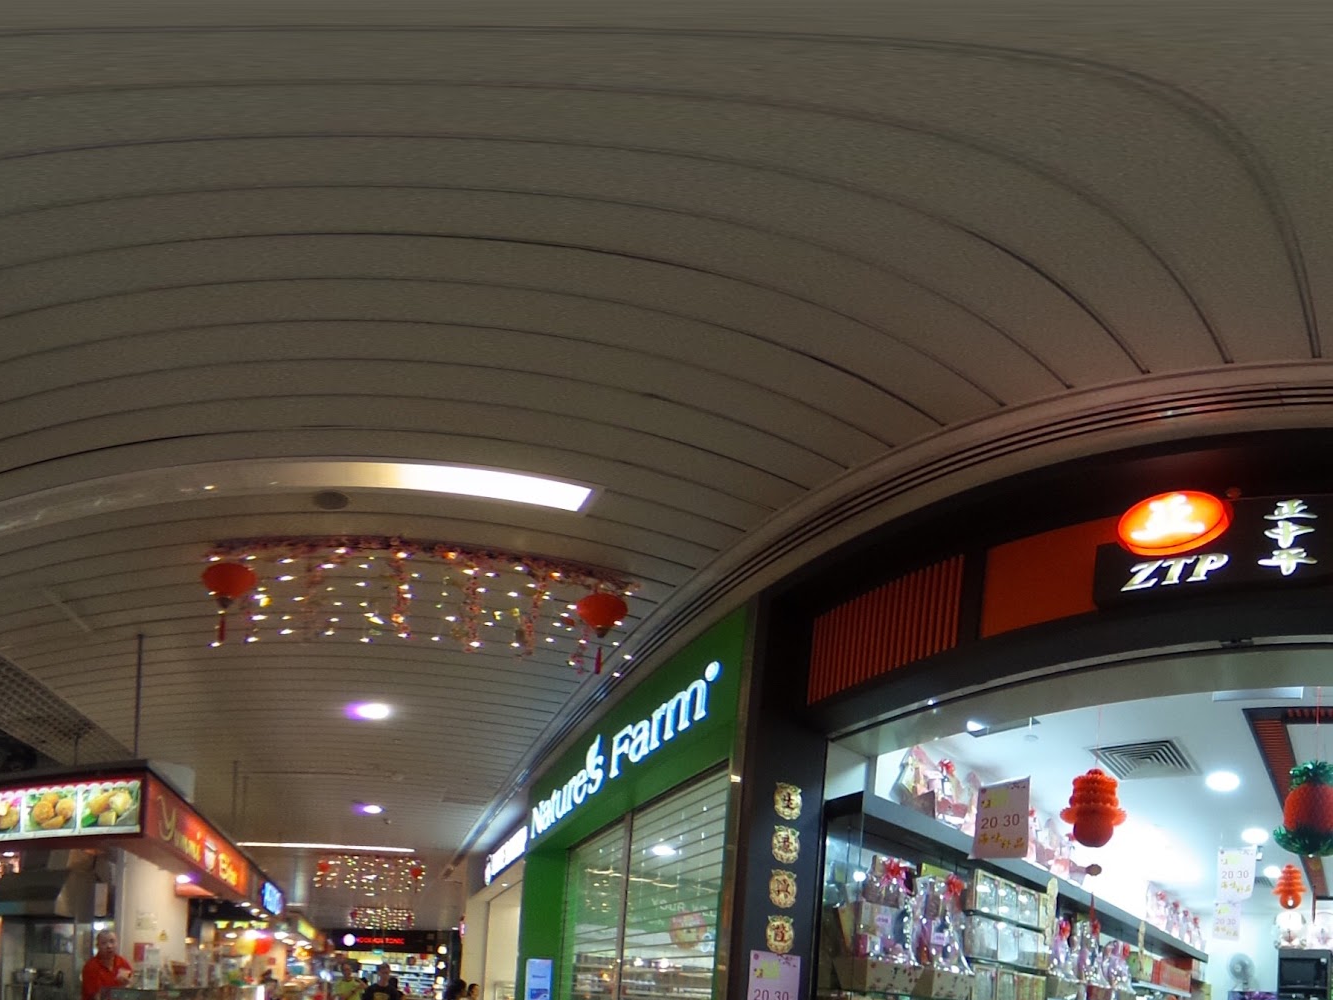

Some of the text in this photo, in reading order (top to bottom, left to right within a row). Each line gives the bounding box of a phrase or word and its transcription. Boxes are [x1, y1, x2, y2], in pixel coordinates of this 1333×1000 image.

[1121, 553, 1229, 592] ZTP
[609, 679, 707, 778] Farm
[980, 813, 1020, 829] 20 30
[1222, 870, 1249, 879] 20 30
